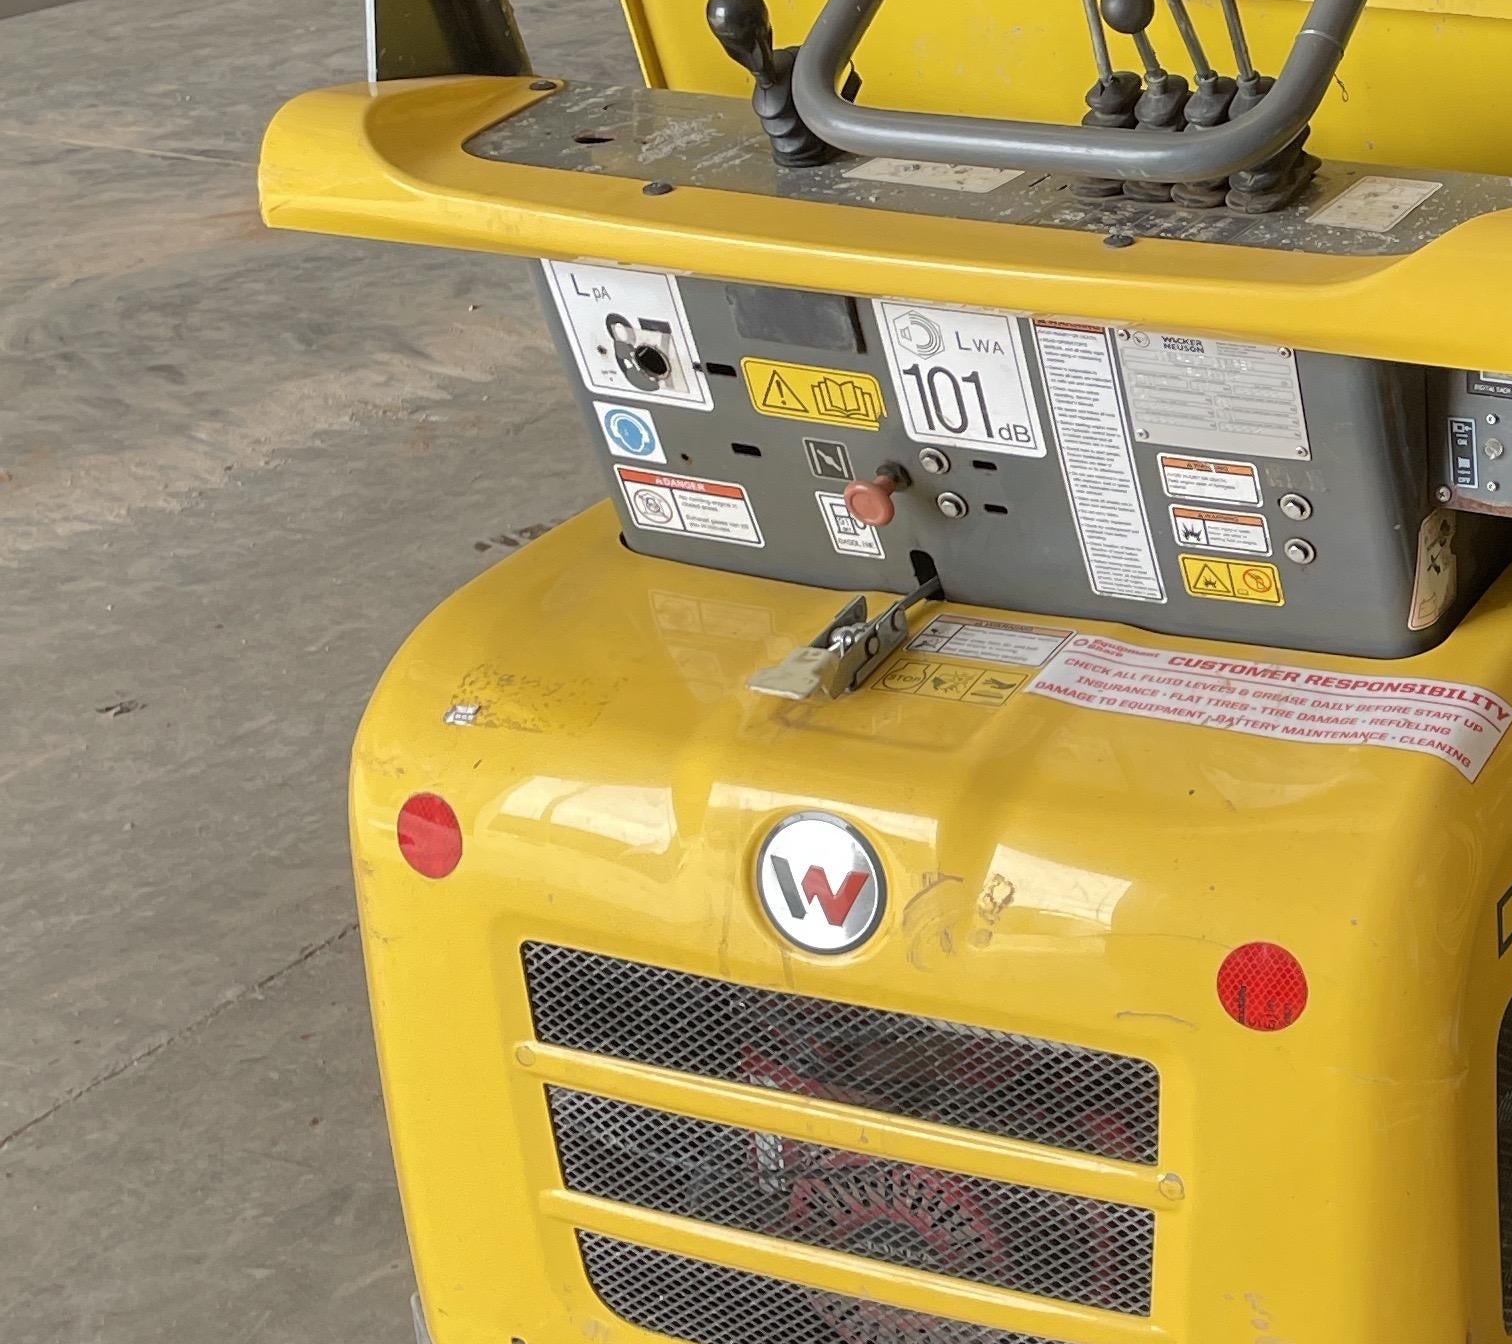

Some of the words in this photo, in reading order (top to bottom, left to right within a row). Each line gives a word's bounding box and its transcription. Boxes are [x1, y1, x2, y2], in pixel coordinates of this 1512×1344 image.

[902, 363, 995, 439] 101
[998, 422, 1031, 444] dB
[1064, 657, 1112, 676] CHECK
[1113, 669, 1137, 681] ALL
[1141, 674, 1184, 687] FLUID
[1185, 680, 1237, 696] LEVELS
[1252, 688, 1309, 707] GREASE
[1311, 699, 1354, 714] DAILY
[1355, 702, 1412, 716] BEFORE
[1413, 708, 1462, 723] START
[1463, 718, 1484, 735] UP
[1075, 675, 1160, 697] INSURANCE
[1170, 691, 1204, 705] FLAT
[1205, 697, 1251, 712] TIRES
[1260, 707, 1295, 720] TIRE
[1296, 712, 1359, 727] DAMAGE
[1368, 717, 1452, 737] REFUELING
[1167, 656, 1302, 683] CUSTOMER
[1304, 673, 1511, 722] RESPONSIBILITY
[1034, 681, 1098, 704] DAMAGE
[1098, 695, 1117, 707] TO
[1118, 699, 1207, 720] EQUIPMENT
[1282, 725, 1389, 742] MAINTENANCE
[1399, 735, 1473, 769] CLEANING
